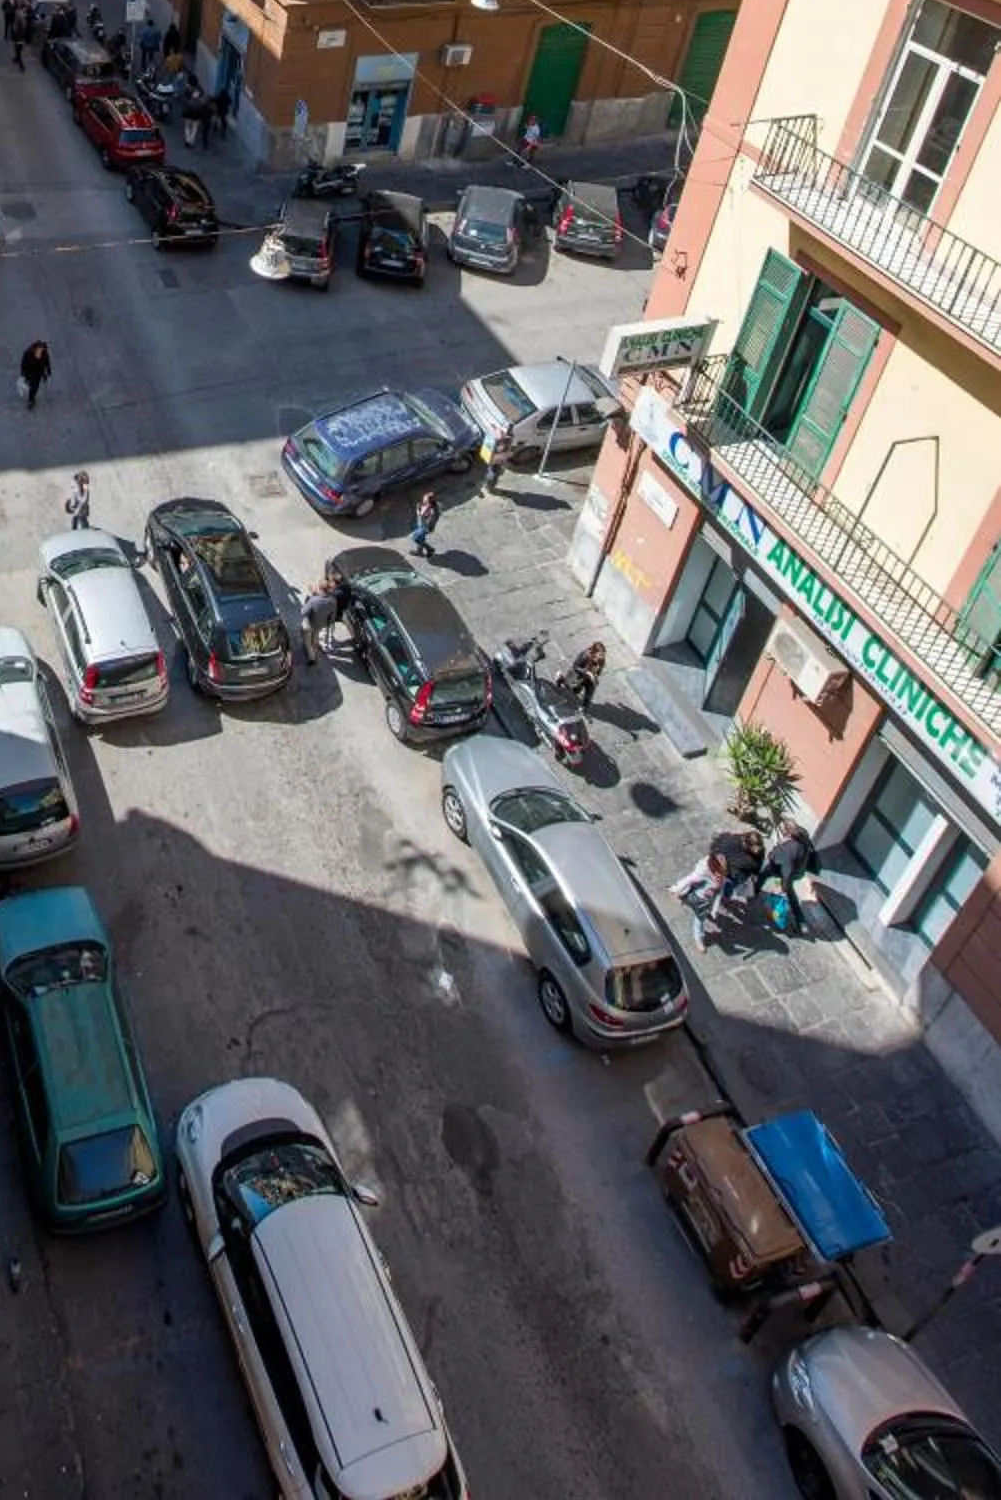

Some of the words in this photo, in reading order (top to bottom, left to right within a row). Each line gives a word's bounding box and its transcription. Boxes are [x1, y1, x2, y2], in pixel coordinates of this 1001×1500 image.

[622, 339, 697, 363] CMN
[766, 538, 856, 642] ANALISI
[861, 633, 988, 778] CLINICHE
